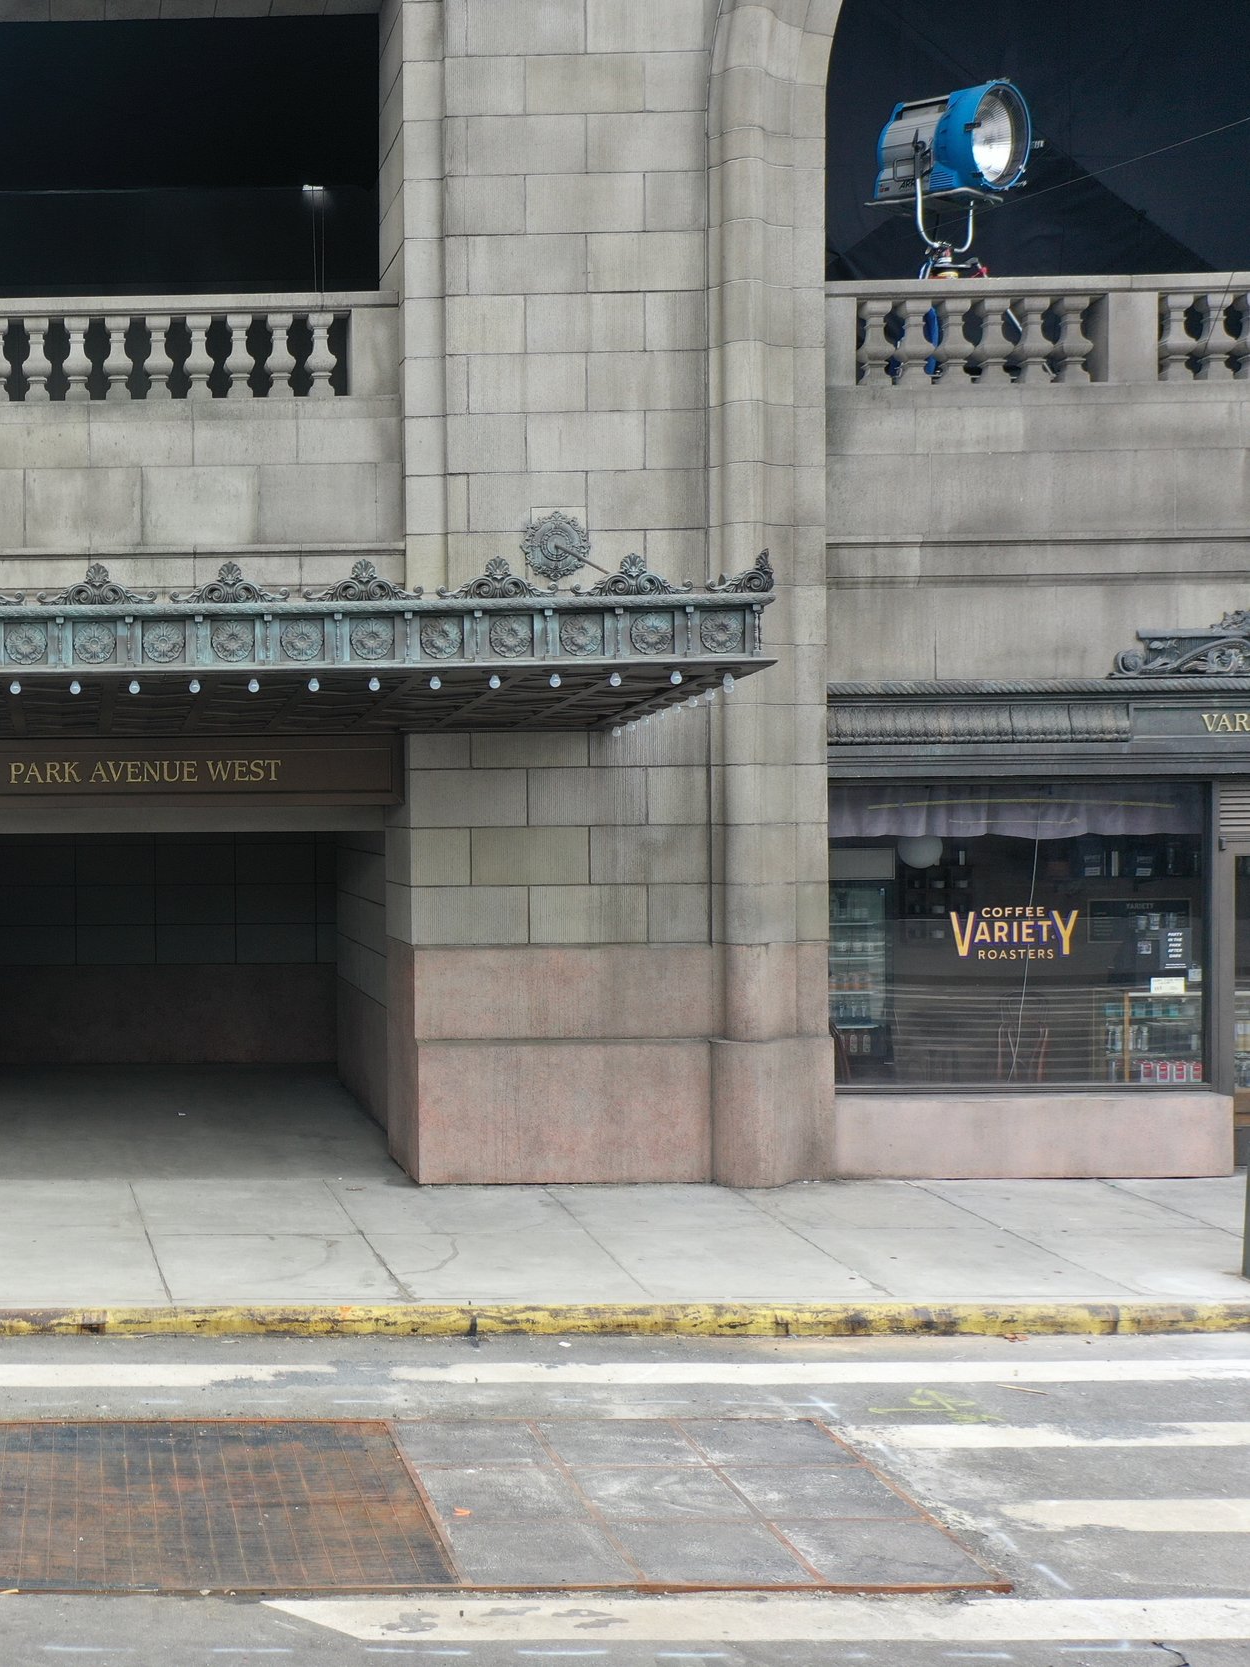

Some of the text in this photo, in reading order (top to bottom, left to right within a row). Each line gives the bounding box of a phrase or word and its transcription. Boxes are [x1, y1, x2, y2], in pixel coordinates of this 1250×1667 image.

[9, 759, 281, 785] PARK AVENUE WEST
[981, 906, 1045, 918] COFFEE
[949, 910, 1079, 957] VARIETY
[978, 949, 1054, 960] ROASTERS
